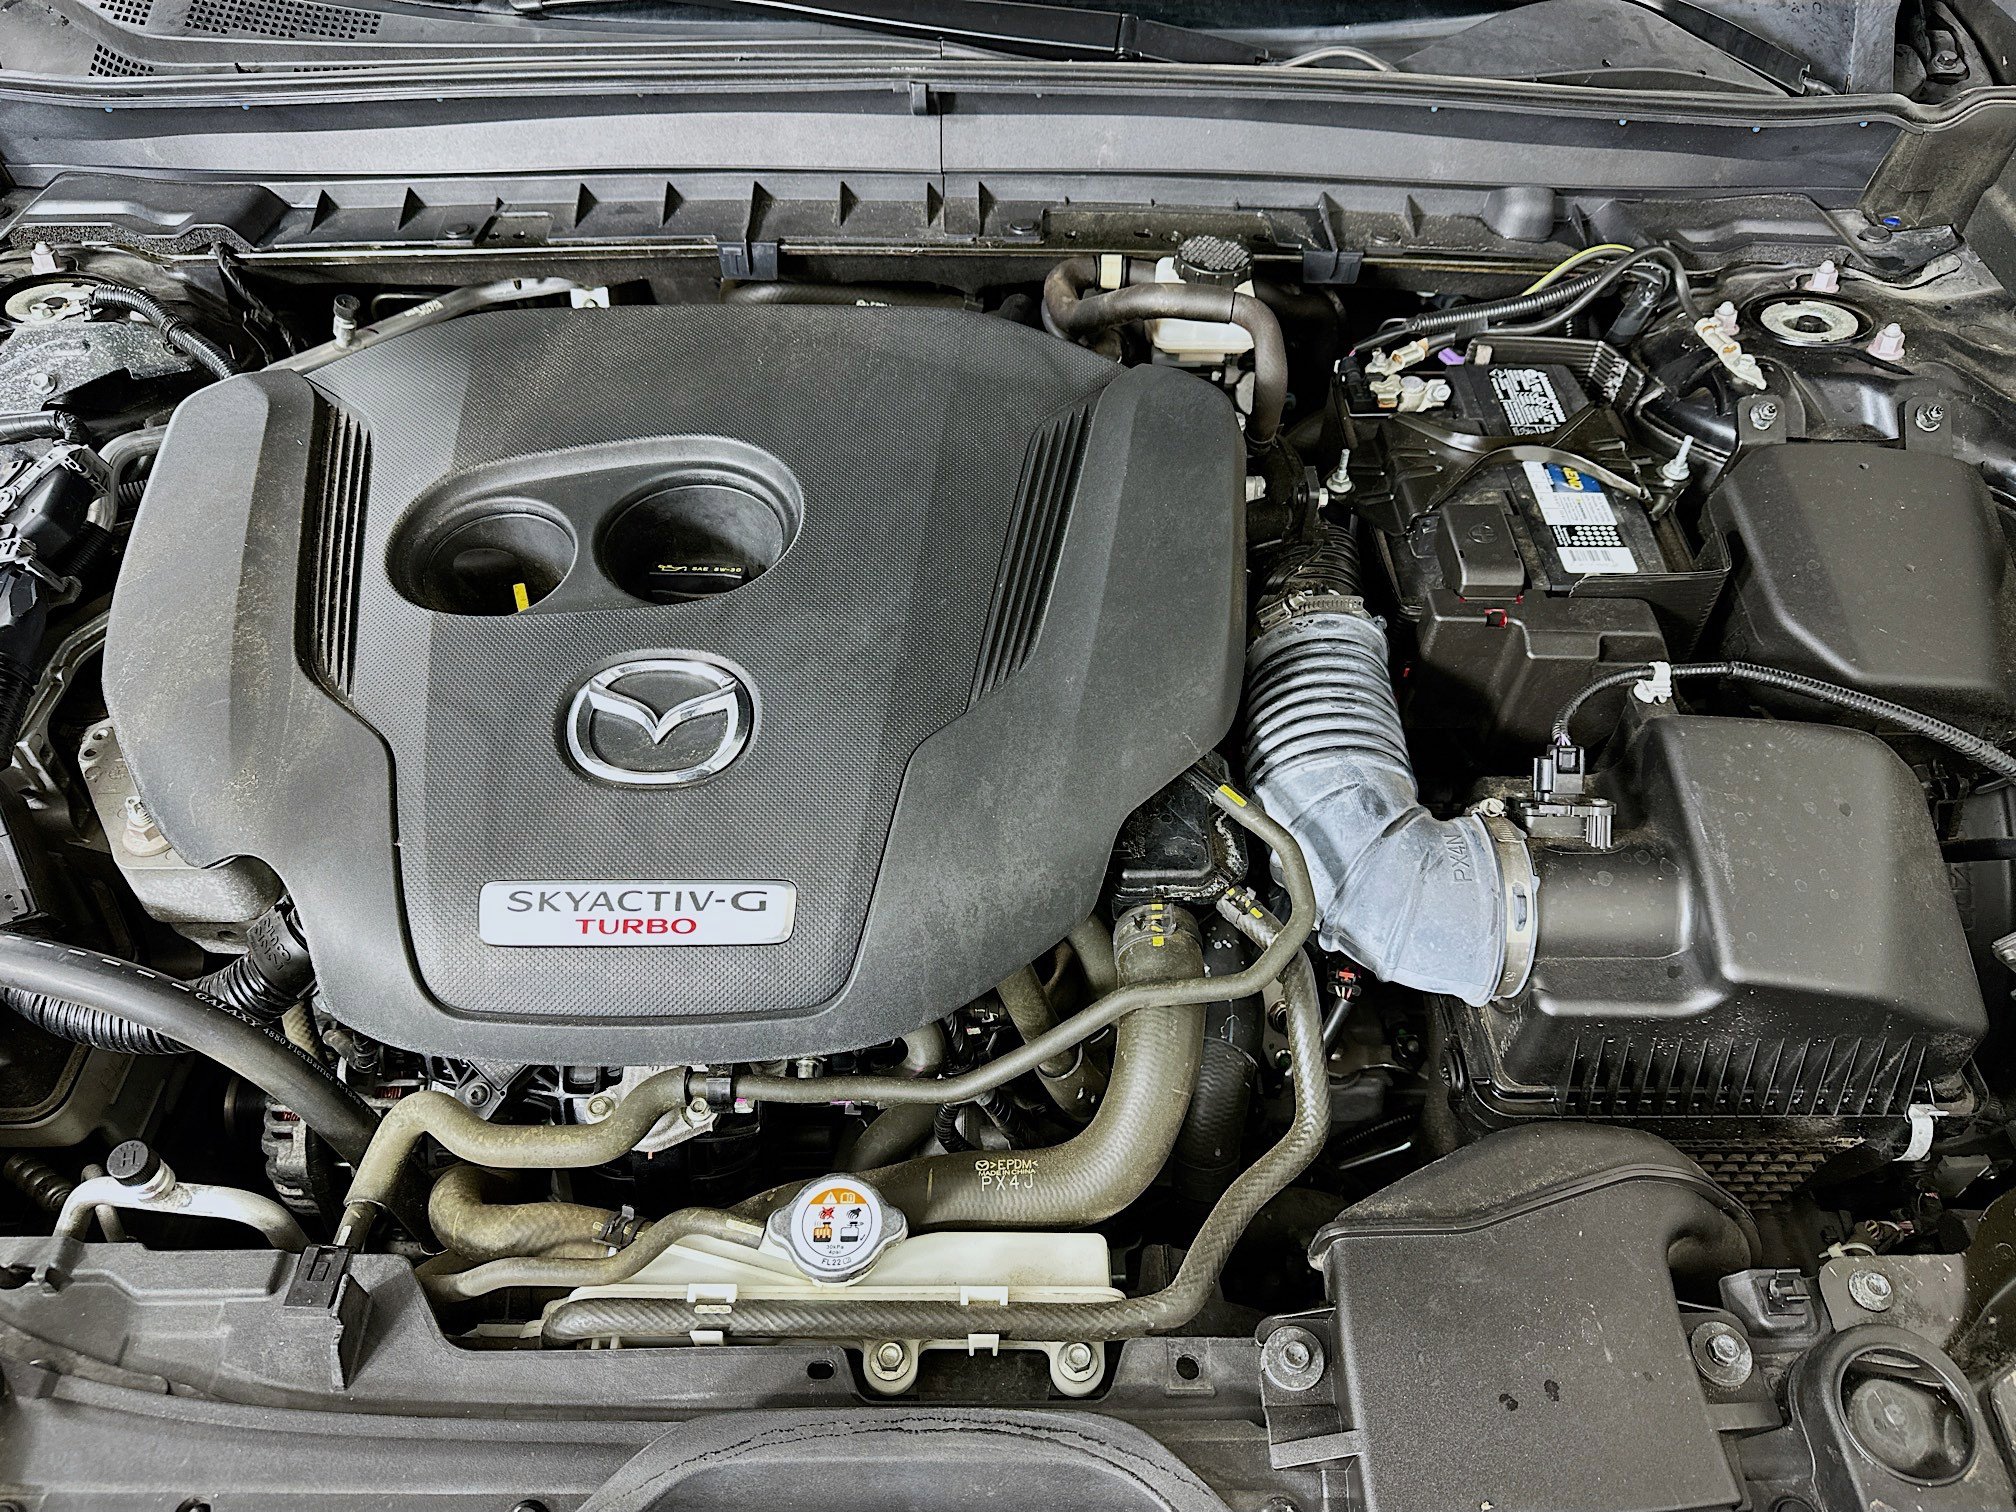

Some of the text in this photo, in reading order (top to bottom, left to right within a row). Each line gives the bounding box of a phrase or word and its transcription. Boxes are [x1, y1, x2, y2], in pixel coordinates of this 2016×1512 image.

[1443, 834, 1473, 881] PX4N
[506, 890, 768, 913] SKYACTIV-G
[575, 918, 697, 935] TURBO
[195, 991, 262, 1028] GALAXY
[263, 1027, 287, 1046] 4880
[1011, 1168, 1036, 1176] CHINA
[981, 1173, 1034, 1192] PX4J
[821, 1257, 842, 1265] FL22
